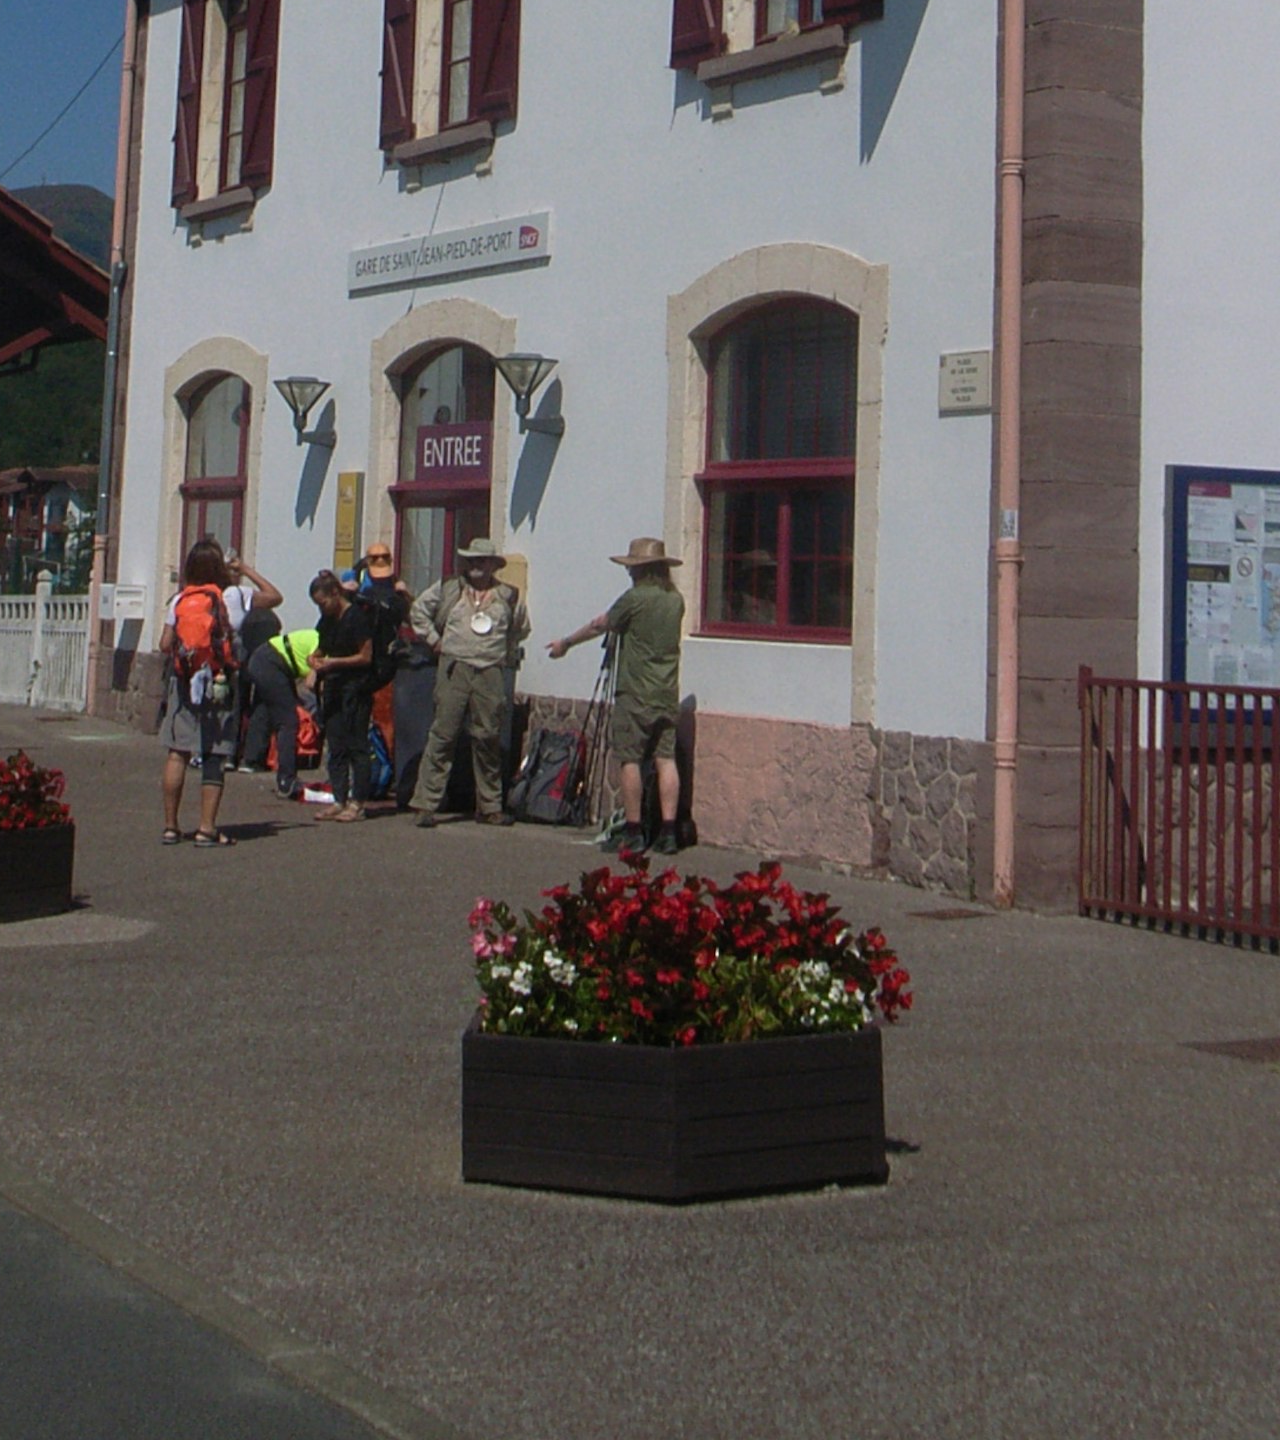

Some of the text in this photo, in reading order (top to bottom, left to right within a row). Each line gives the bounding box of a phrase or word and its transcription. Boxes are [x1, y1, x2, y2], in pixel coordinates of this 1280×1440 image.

[355, 259, 378, 277] GARE
[379, 255, 392, 273] DE
[423, 435, 482, 468] ENTREE
